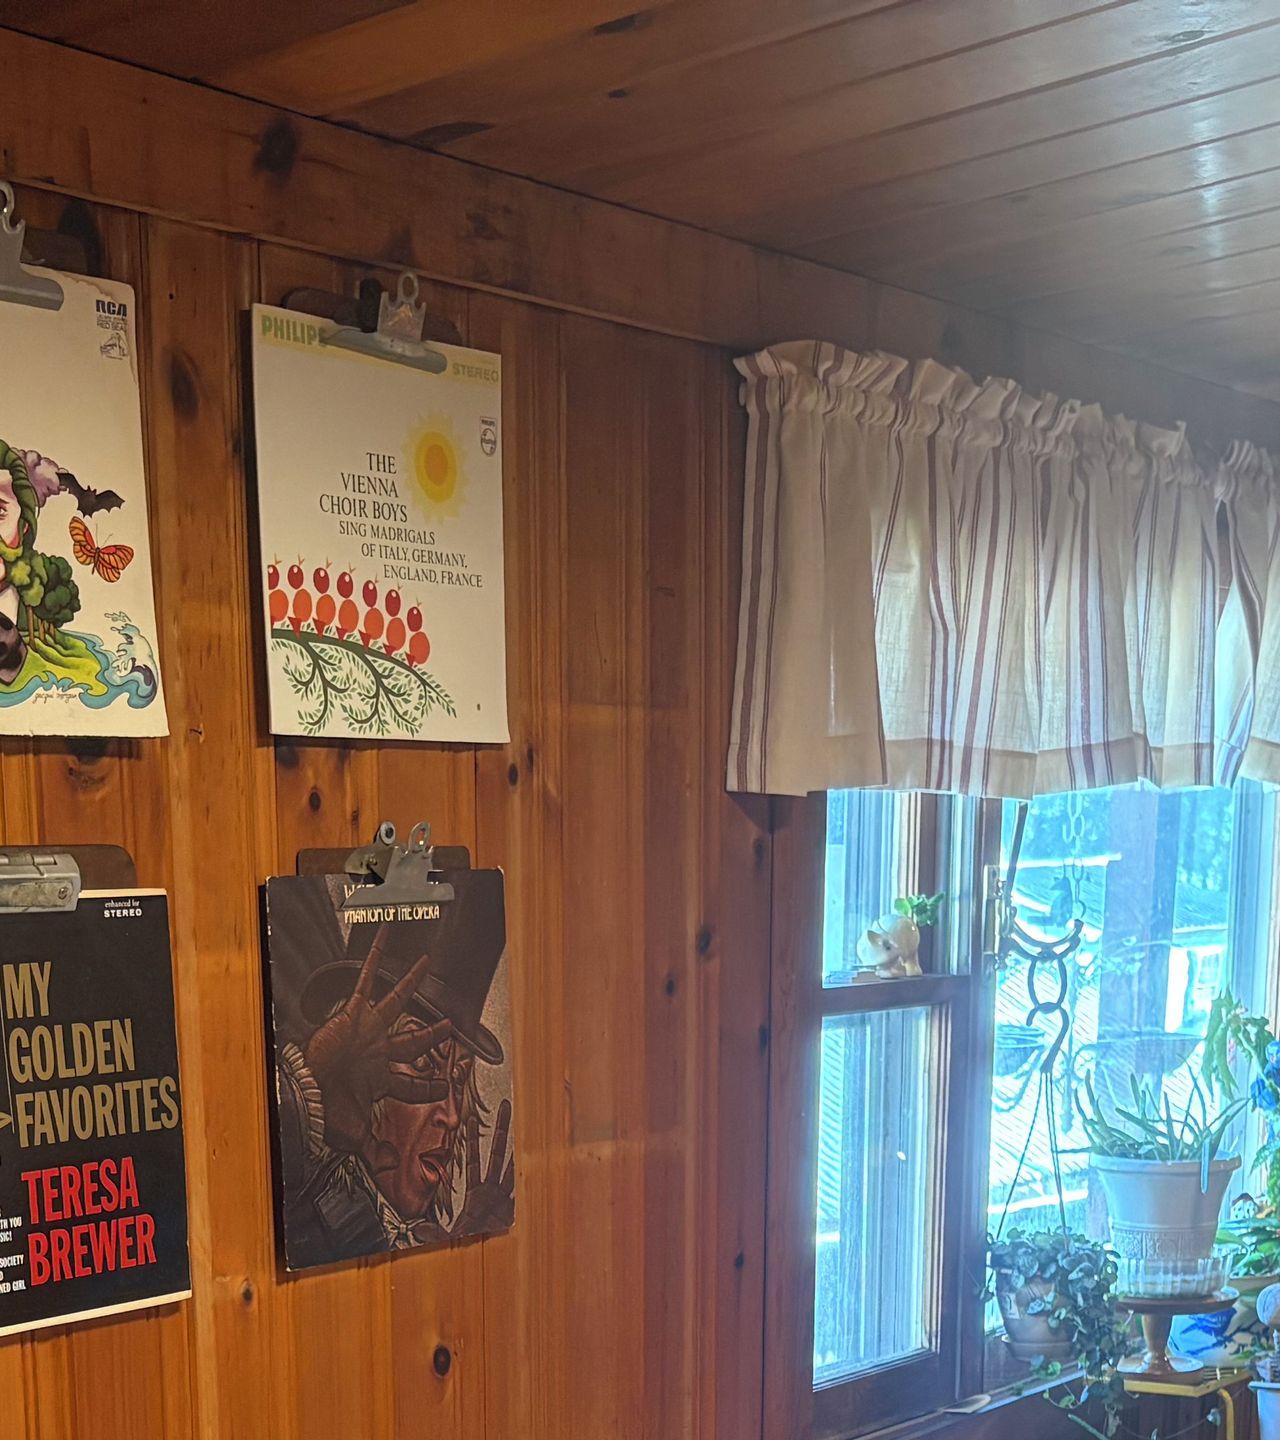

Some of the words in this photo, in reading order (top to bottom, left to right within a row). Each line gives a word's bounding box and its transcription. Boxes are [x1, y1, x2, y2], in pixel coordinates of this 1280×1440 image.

[95, 299, 127, 317] RCA
[453, 362, 500, 383] STEREO
[366, 452, 397, 474] THE
[340, 472, 399, 498] VIENNA
[319, 494, 369, 518] CHOIR
[373, 501, 408, 523] BOYS
[339, 520, 367, 537] SING
[370, 525, 436, 545] MADRIGALS
[361, 543, 376, 558] OF
[441, 571, 483, 588] FRANCE
[104, 908, 142, 918] STEREO
[384, 907, 395, 922] OF
[413, 905, 440, 920] OPERA
[2, 961, 52, 1019] MY
[8, 1018, 136, 1083] GOLDEN
[15, 1076, 180, 1148] FAVORITES
[21, 1156, 139, 1225] TERESA
[9, 1216, 23, 1228] YOU
[27, 1213, 157, 1287] BREWER
[0, 1254, 25, 1269] SOCIETY
[12, 1279, 27, 1291] GIRL
